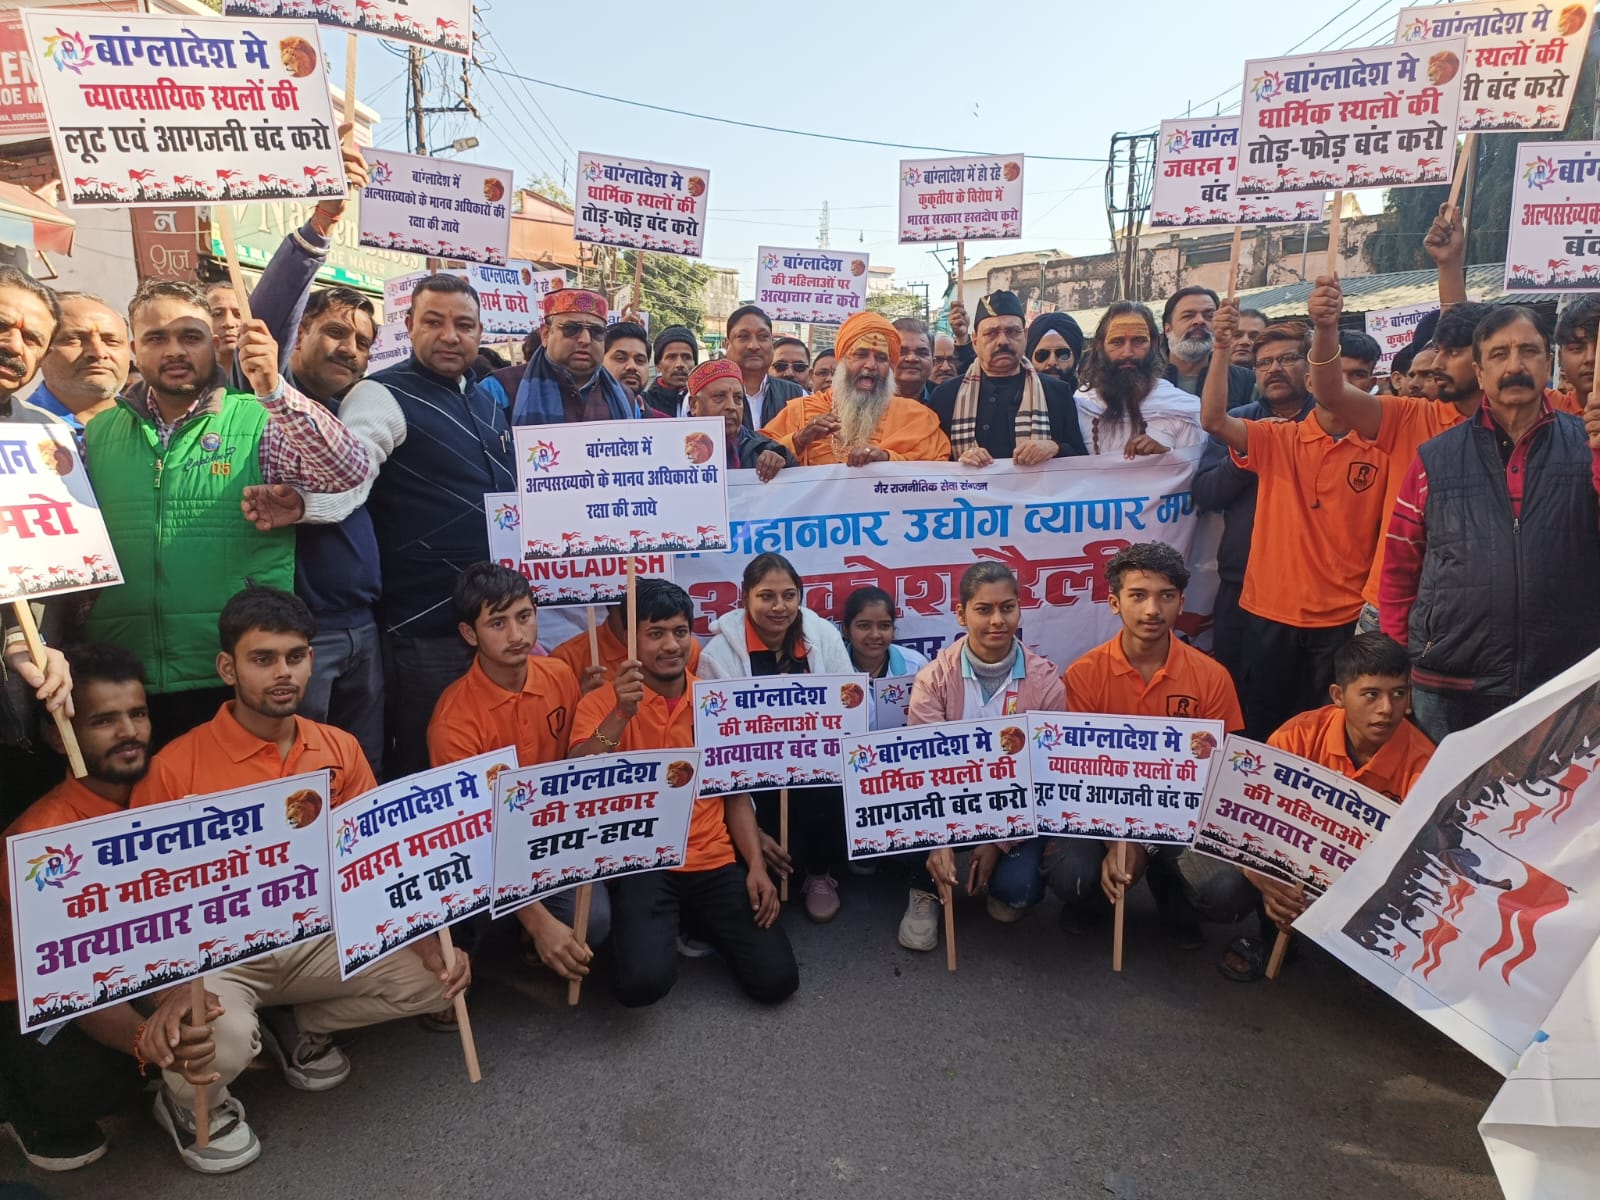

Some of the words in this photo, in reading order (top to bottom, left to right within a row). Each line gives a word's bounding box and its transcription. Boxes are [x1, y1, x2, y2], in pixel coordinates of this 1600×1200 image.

[1432, 8, 1528, 38] बांग्लादेश
[1532, 4, 1552, 32] मे
[89, 26, 237, 69] बांग्लादेश
[240, 31, 270, 70] मे
[1476, 39, 1536, 67] स्थलों
[1536, 38, 1568, 64] की
[1284, 58, 1392, 94] बांग्लादेश
[1397, 52, 1420, 82] मे
[1487, 72, 1520, 100] बंद
[1524, 69, 1569, 99] करो
[79, 78, 205, 111] व्यावसायिक
[208, 79, 266, 111] स्थलों
[268, 78, 299, 111] की
[1258, 99, 1334, 129] धार्मिक
[1338, 90, 1404, 122] स्थलों
[1406, 86, 1443, 115] की
[59, 126, 105, 164] लूट
[108, 118, 148, 153] एवं
[153, 119, 248, 153] आगजनी
[250, 118, 285, 152] बंद
[288, 118, 332, 151] करो
[1248, 130, 1349, 168] तोड़-फोड़
[1354, 124, 1392, 155] बंद
[1397, 120, 1447, 151] करो
[412, 168, 450, 188] बांग्लादेश
[452, 174, 462, 189] में
[603, 162, 667, 188] बांग्लादेश
[923, 165, 965, 184] बांग्लादेश
[967, 164, 977, 182] में
[977, 164, 988, 182] हो
[990, 163, 1002, 181] रहे
[1163, 157, 1224, 177] जबरन
[418, 191, 428, 206] के
[429, 195, 452, 210] मानव
[493, 205, 505, 219] की
[637, 193, 675, 211] स्थलों
[676, 196, 696, 214] की
[955, 188, 965, 204] के
[995, 186, 1005, 202] में
[1201, 179, 1230, 202] बंद
[427, 216, 439, 230] की
[441, 219, 460, 233] जाये
[582, 203, 643, 232] तोड़-फोड़
[646, 212, 668, 232] बंद
[671, 217, 699, 236] करो
[931, 213, 962, 225] सरकार
[1000, 207, 1019, 221] करो
[783, 253, 843, 272] बांग्लादेश
[771, 273, 786, 285] की
[788, 274, 837, 288] महिलाओं
[837, 279, 851, 290] पर
[479, 288, 502, 311] शर्म
[503, 290, 529, 313] करो
[761, 289, 812, 304] अत्याचार
[815, 290, 834, 304] बंद
[836, 291, 860, 308] करो
[586, 438, 639, 459] बांग्लादेश
[641, 436, 653, 455] में
[596, 469, 609, 488] के
[612, 471, 645, 487] मानव
[648, 465, 699, 486] अधिकारों
[701, 465, 719, 484] की
[874, 480, 889, 494] गैर
[890, 480, 938, 494] राजनीतिक
[940, 479, 958, 492] सेवा
[586, 502, 609, 520] रक्षा
[612, 498, 629, 518] की
[631, 497, 658, 518] जाये
[728, 511, 890, 555] महानगर
[903, 498, 1012, 542] उद्योग
[1025, 497, 1149, 534] व्यापार
[733, 682, 827, 709] बांग्लादेश
[717, 717, 741, 737] की
[744, 712, 819, 734] महिलाओं
[821, 715, 842, 730] पर
[1062, 721, 1159, 751] बांग्लादेश
[1163, 725, 1183, 752] मे
[704, 740, 784, 767] अत्याचार
[788, 734, 818, 759] बंद
[876, 731, 969, 764] बांग्लादेश
[973, 727, 992, 753] मे
[540, 759, 661, 797] बांग्लादेश
[859, 768, 925, 796] धार्मिक
[929, 758, 985, 787] स्थलों
[987, 756, 1016, 780] की
[1048, 755, 1130, 778] व्यावसायिक
[1133, 758, 1174, 781] स्थलों
[1175, 759, 1197, 782] की
[357, 781, 454, 838] बांग्लादेश
[456, 770, 479, 799] मे
[530, 800, 569, 827] की
[574, 791, 659, 819] सरकार
[855, 792, 945, 828] आगजनी
[949, 788, 982, 815] बंद
[986, 783, 1028, 811] करो
[1058, 780, 1083, 803] एवं
[1086, 784, 1156, 807] आगजनी
[1156, 785, 1180, 809] बंद
[1274, 762, 1390, 832] बांग्लादेश
[1215, 798, 1318, 854] अत्याचार
[1244, 783, 1274, 806] की
[1277, 794, 1370, 850] महिलाओं
[92, 803, 265, 866] बांग्लादेश
[528, 817, 659, 861] हाय-हाय
[63, 883, 110, 920] की
[115, 844, 252, 905] महिलाओं
[256, 841, 291, 868] पर
[338, 841, 403, 894] जबरन
[385, 873, 423, 909] बंद
[424, 851, 473, 893] करो
[36, 903, 193, 977] अत्याचार
[199, 885, 251, 925] बंद
[257, 864, 319, 908] करो
